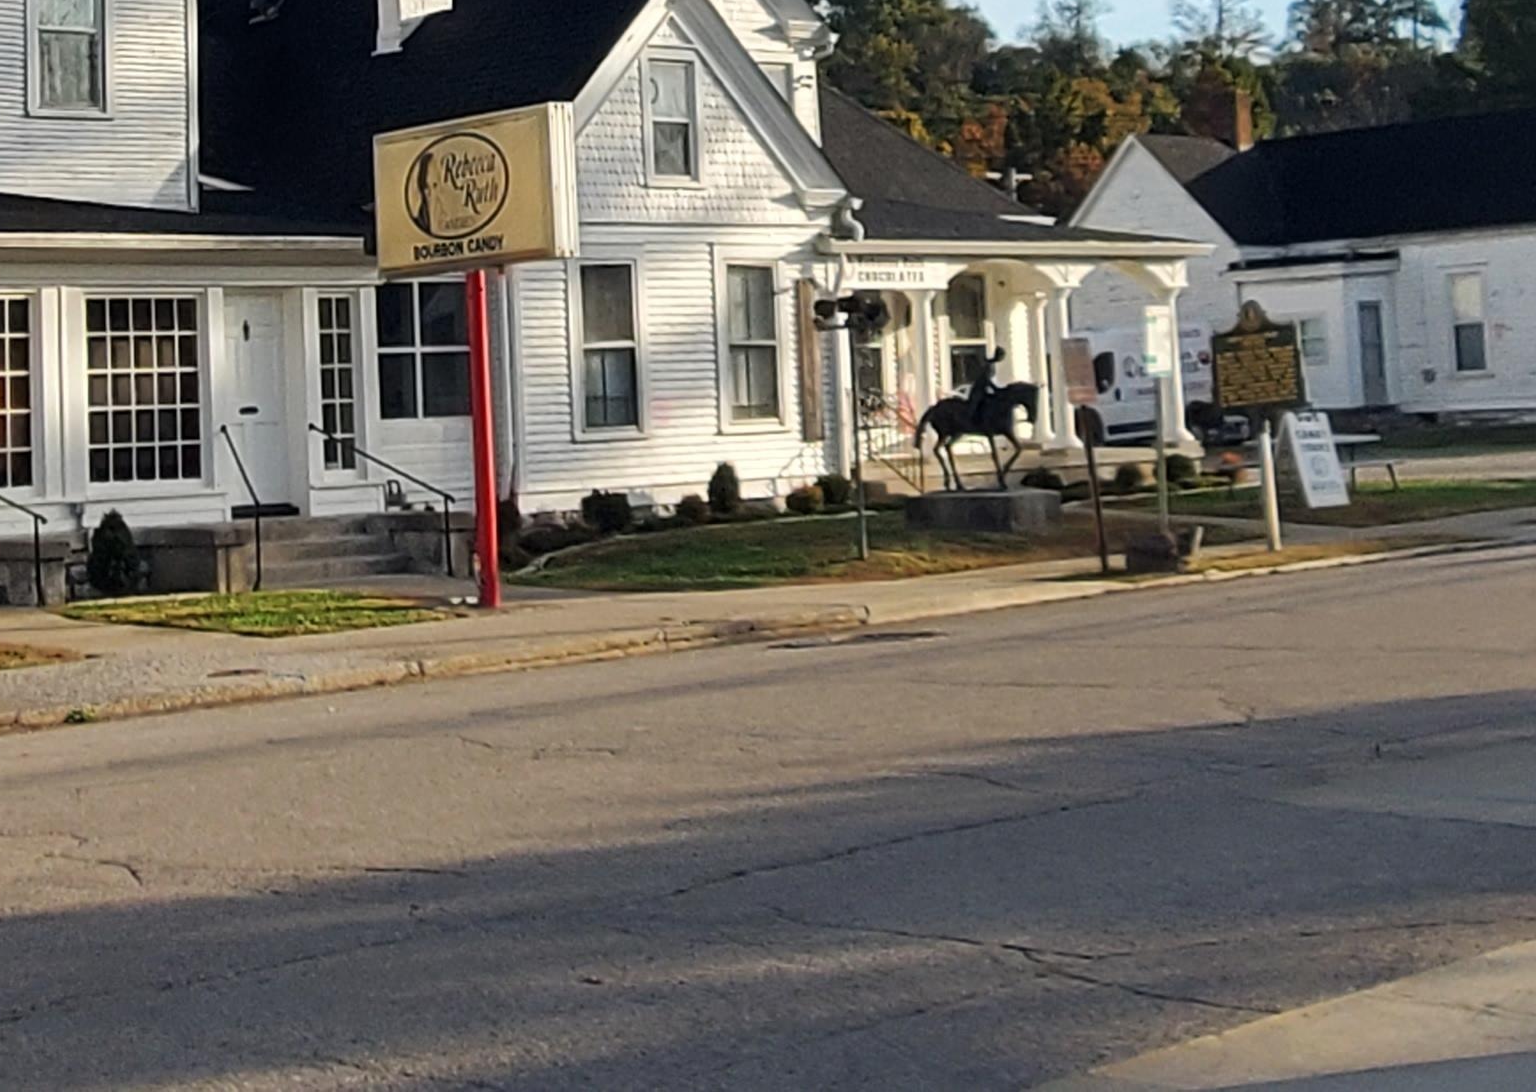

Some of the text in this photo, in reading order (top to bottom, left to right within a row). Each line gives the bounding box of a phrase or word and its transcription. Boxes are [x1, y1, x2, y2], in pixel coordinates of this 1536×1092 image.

[464, 178, 498, 214] Ruth
[414, 234, 503, 260] BOURBON CANDY
